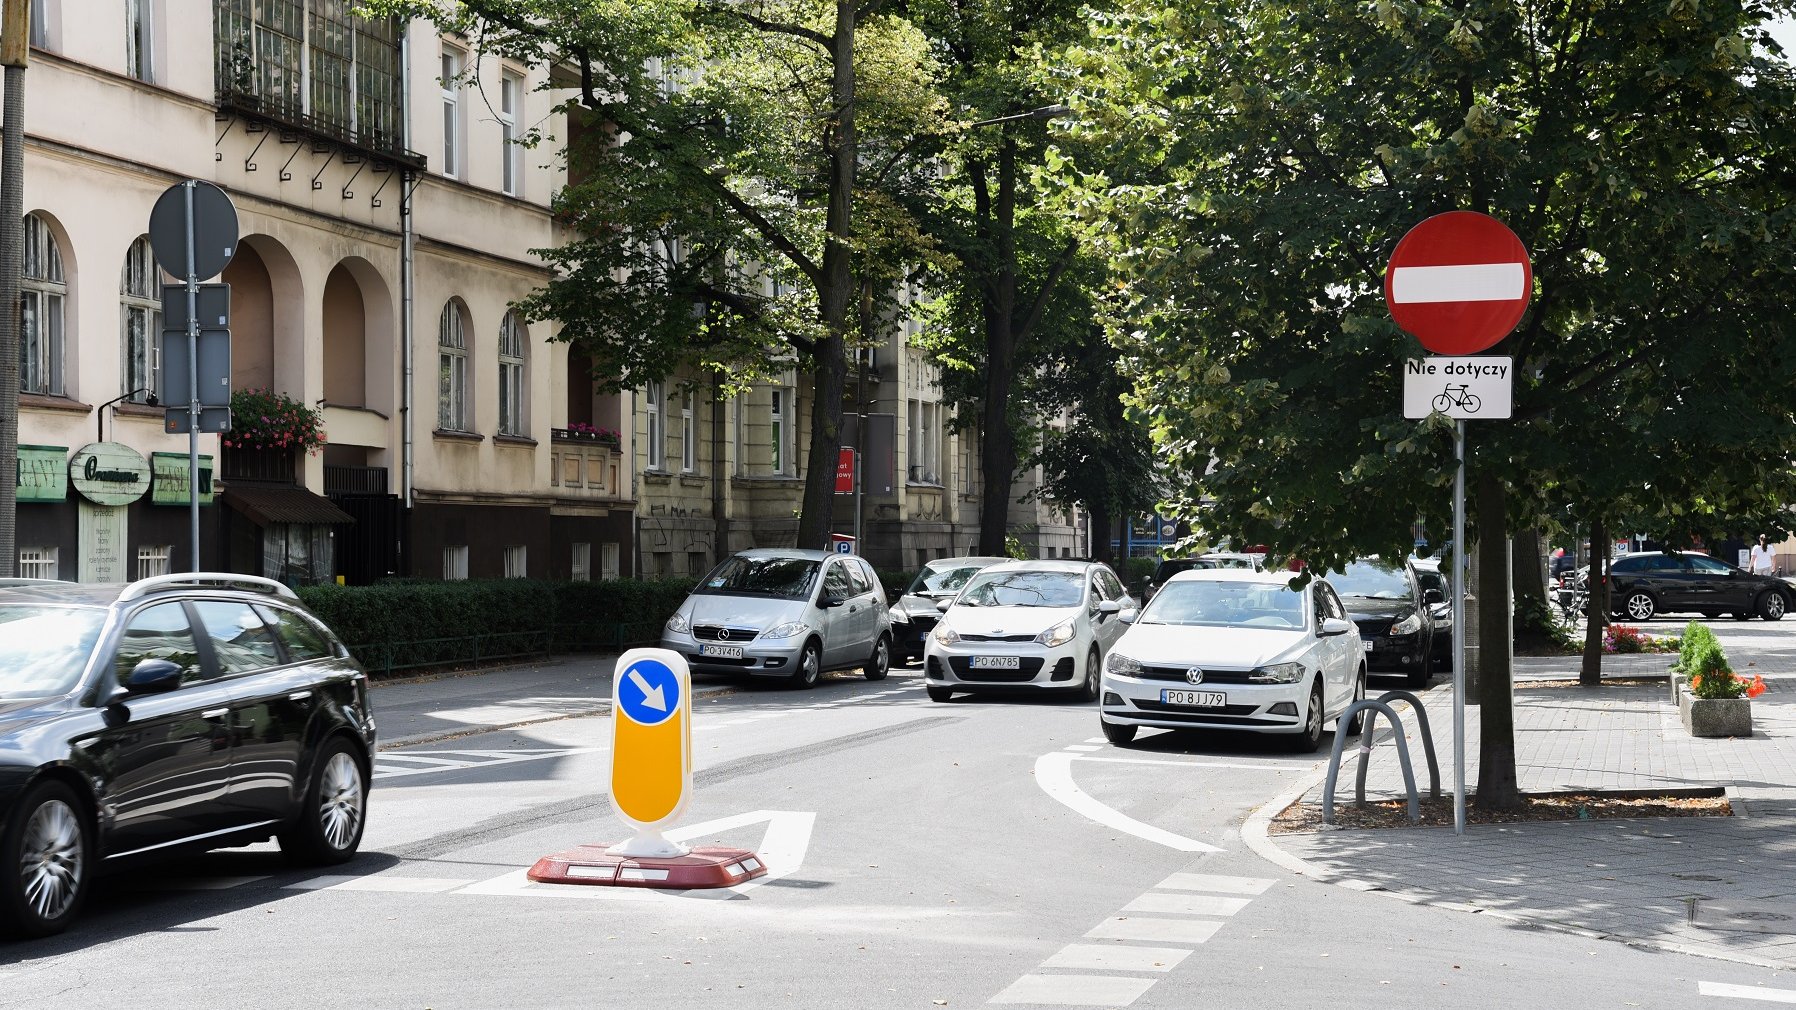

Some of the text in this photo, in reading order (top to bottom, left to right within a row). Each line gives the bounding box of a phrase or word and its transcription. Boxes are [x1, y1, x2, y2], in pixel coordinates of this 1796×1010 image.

[1409, 361, 1507, 379] Nie dotyczy
[17, 458, 58, 487] RANY
[704, 645, 741, 657] PO 3V416
[974, 657, 1018, 666] PO 6N785
[1168, 691, 1223, 706] PO 8JJ79
